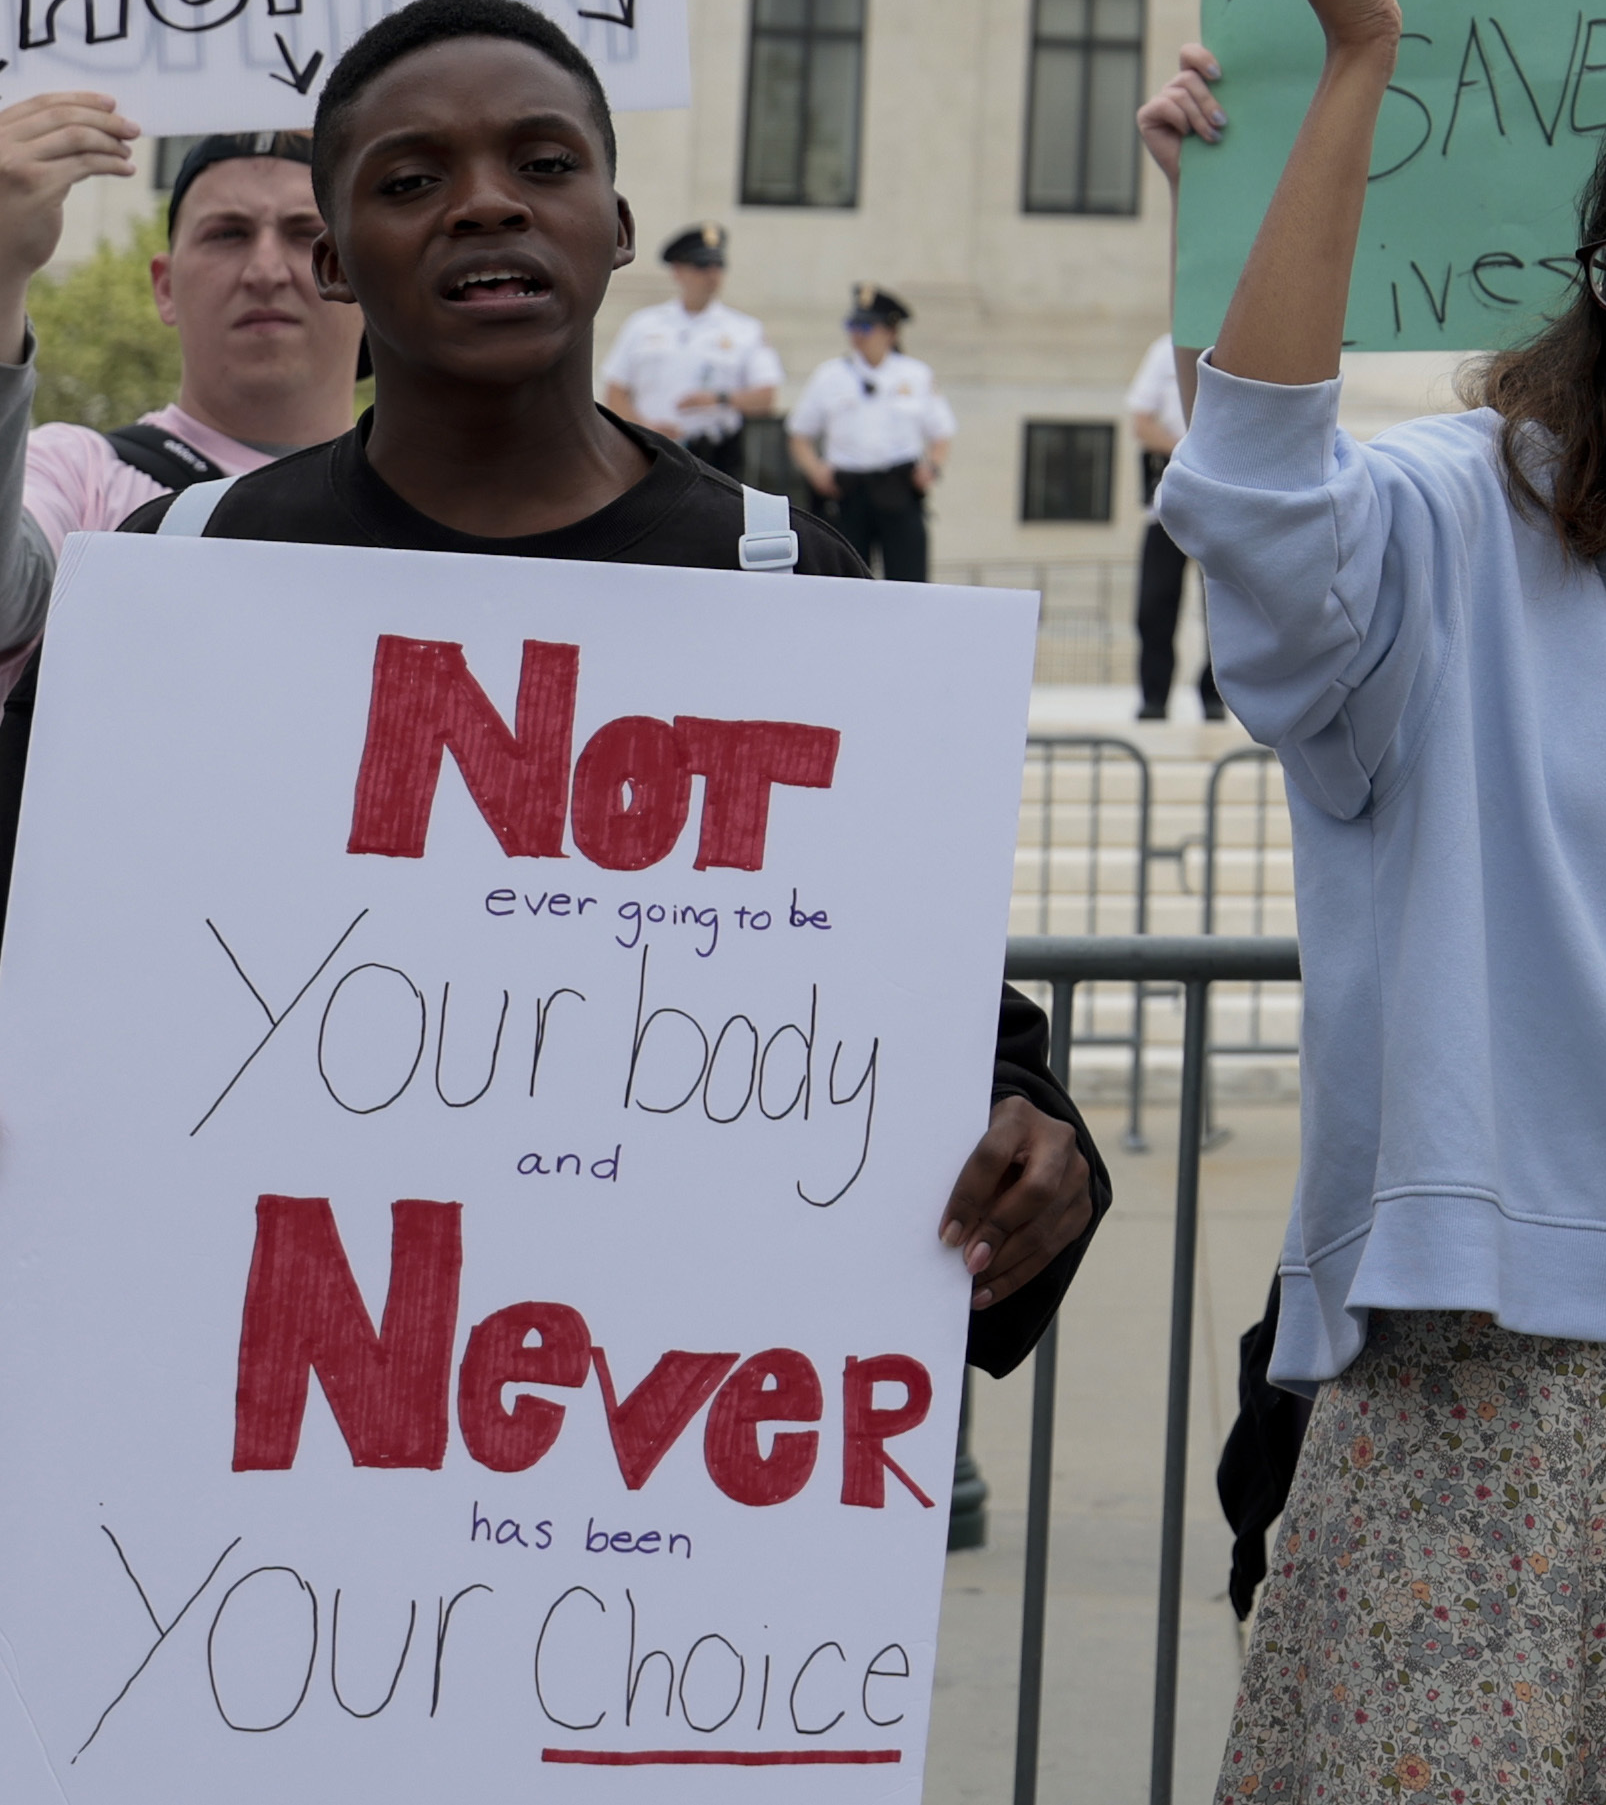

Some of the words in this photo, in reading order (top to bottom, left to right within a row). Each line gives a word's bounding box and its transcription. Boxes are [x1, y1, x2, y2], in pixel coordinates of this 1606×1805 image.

[484, 884, 598, 919] ever
[616, 893, 720, 957] going
[733, 901, 771, 934] to
[787, 887, 833, 933] be
[622, 944, 879, 1209] body
[515, 1143, 622, 1183] and
[469, 1501, 554, 1552] has
[584, 1517, 693, 1560] been
[533, 1585, 910, 1736] Choice
